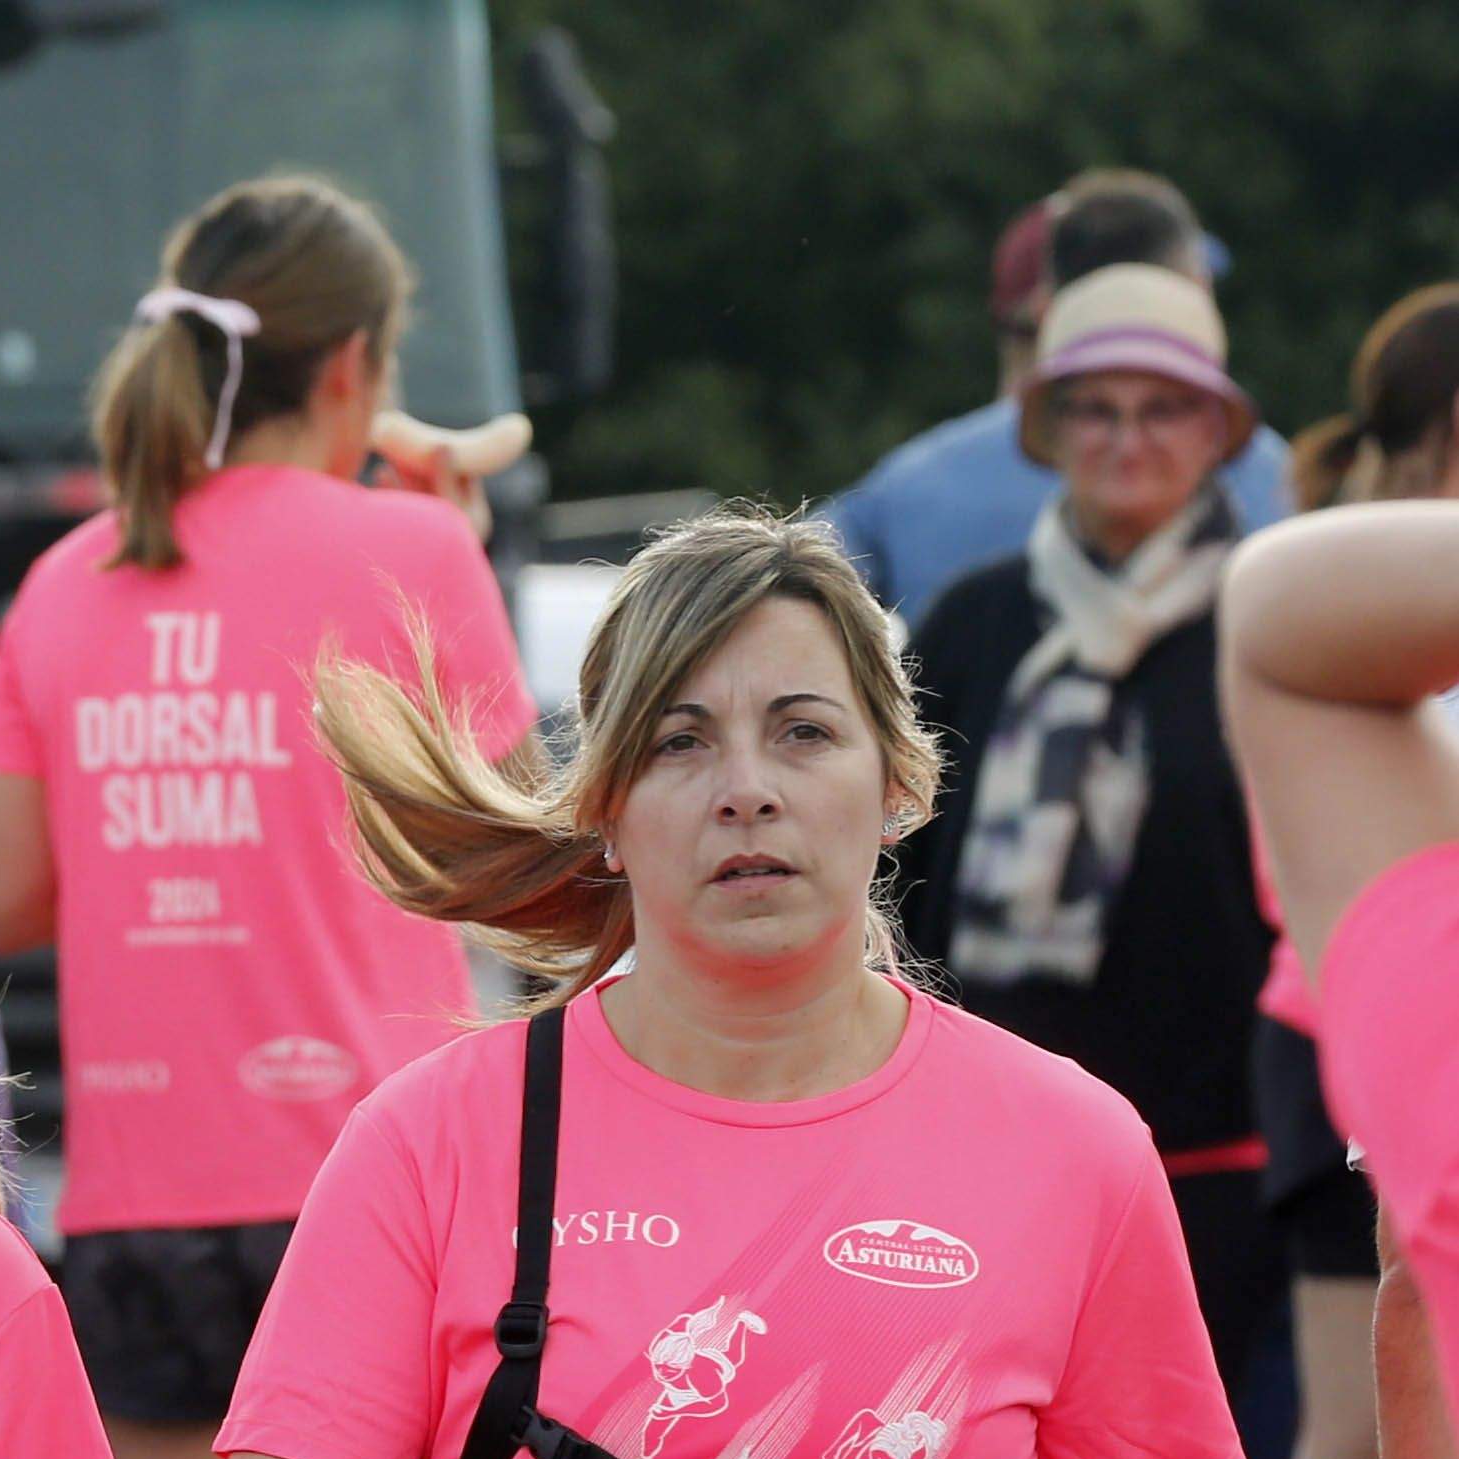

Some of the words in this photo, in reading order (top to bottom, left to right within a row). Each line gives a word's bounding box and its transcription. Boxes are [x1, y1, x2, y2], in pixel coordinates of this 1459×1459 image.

[145, 612, 222, 686] TU
[76, 692, 291, 772] DORSAL
[102, 772, 263, 850] SUMA
[512, 1210, 680, 1248] YSHO
[835, 1238, 968, 1278] ASTURIANA
